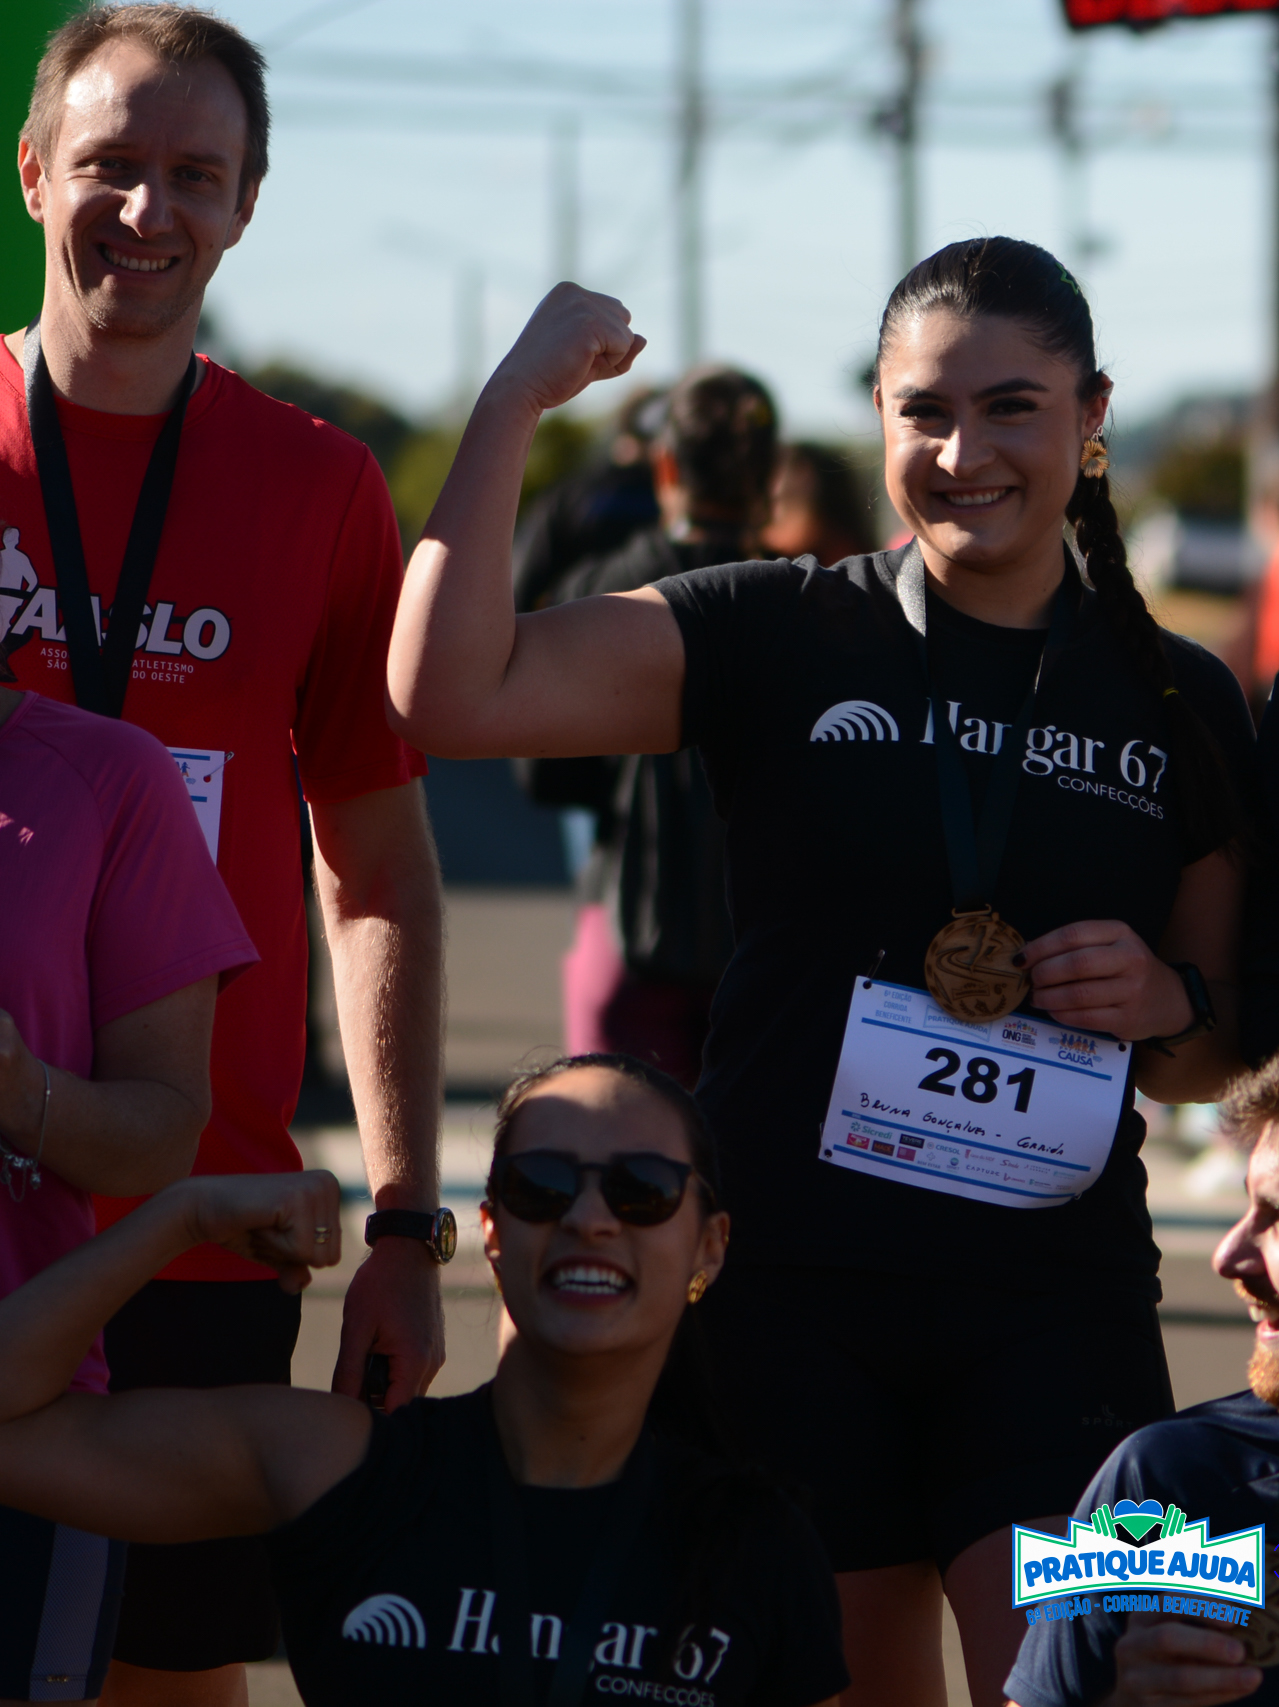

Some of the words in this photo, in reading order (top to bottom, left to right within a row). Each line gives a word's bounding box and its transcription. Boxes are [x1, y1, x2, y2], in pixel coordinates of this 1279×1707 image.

[46, 659, 67, 671] SÃO
[132, 670, 146, 681] DO
[150, 671, 185, 684] OESTE
[132, 660, 194, 674] ATLETISMO
[1119, 739, 1169, 795] 67
[1057, 774, 1164, 820] CONFECÇÕES
[884, 1001, 908, 1012] CORRIDA
[875, 1009, 912, 1024] BENEFICENTE
[1001, 1028, 1022, 1042] ONG
[1058, 1050, 1094, 1068] CAUSA
[917, 1046, 1036, 1114] 281
[862, 1125, 893, 1140] Sicredi
[935, 1144, 961, 1155] CRESOL
[673, 1624, 732, 1685] 67
[595, 1673, 716, 1707] CONFECÇÕES
